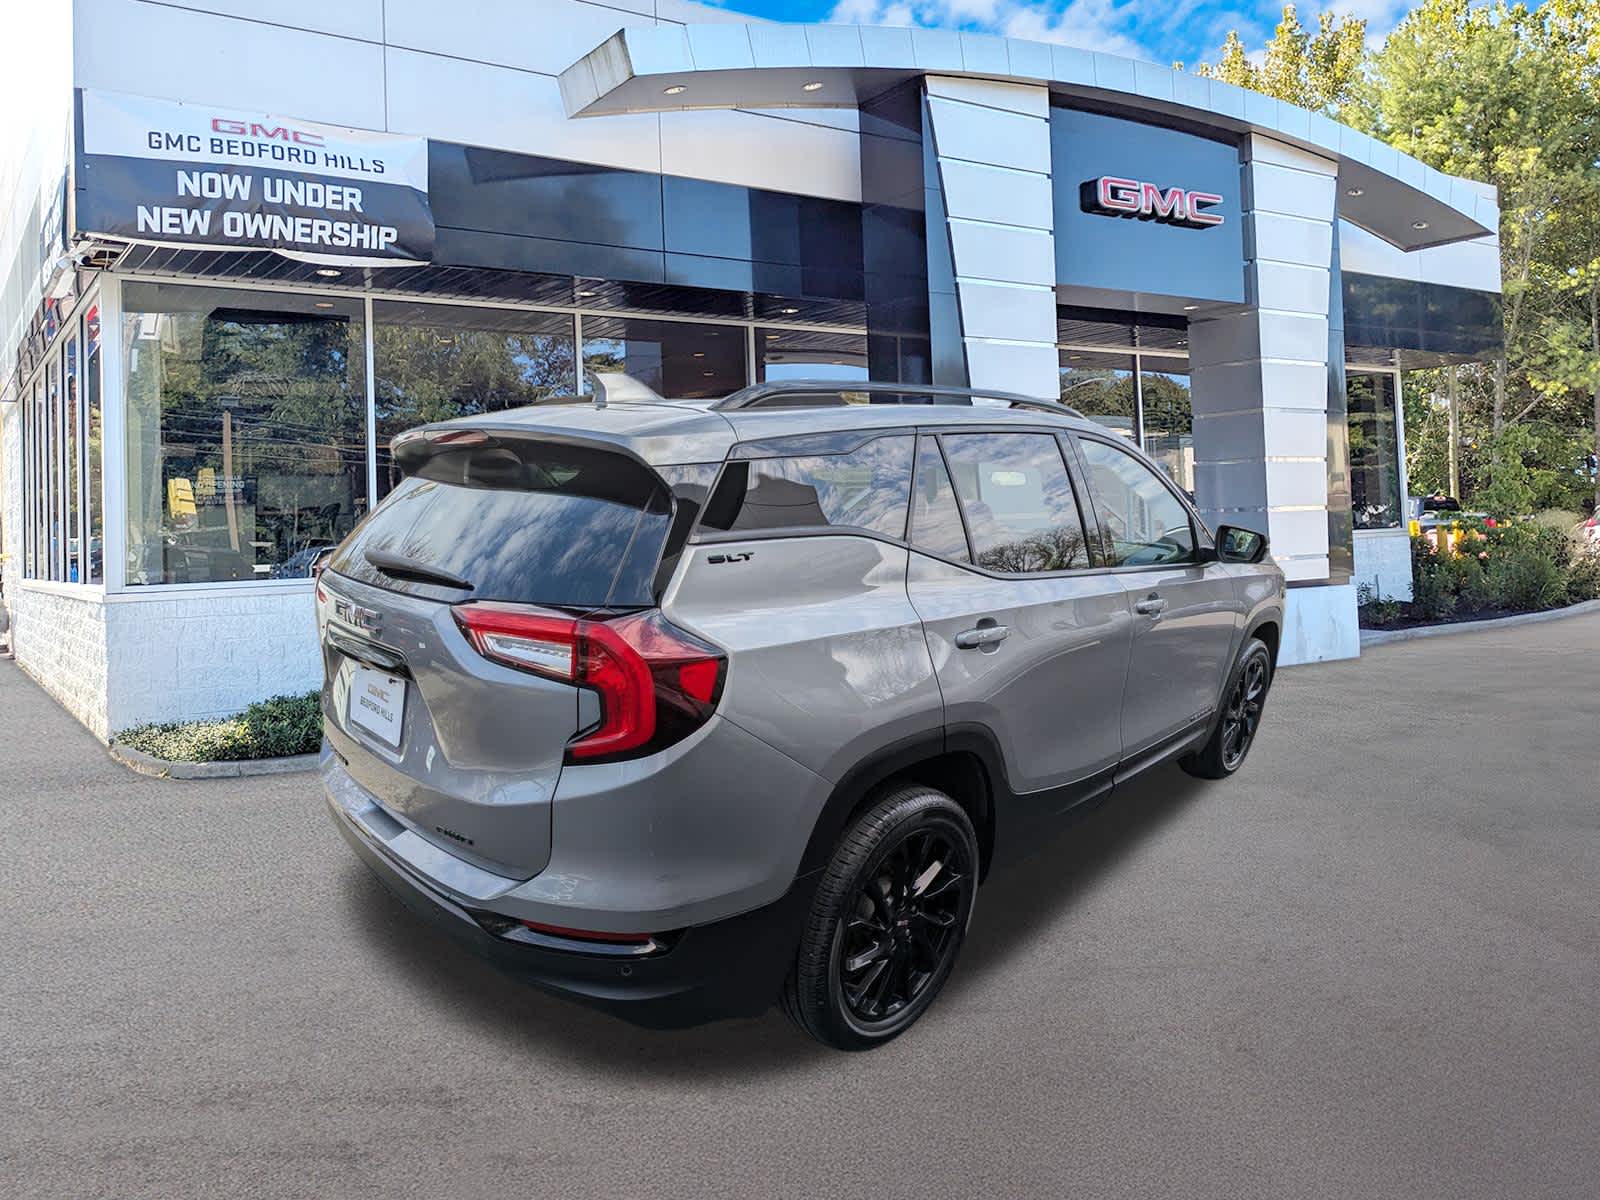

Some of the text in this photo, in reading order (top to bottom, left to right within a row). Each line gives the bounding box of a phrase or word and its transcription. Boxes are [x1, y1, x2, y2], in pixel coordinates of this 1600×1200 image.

[147, 131, 385, 174] GMC BEDFORD HILLS
[211, 118, 326, 148] GMC
[176, 170, 364, 213] NOW UNDER
[1094, 175, 1225, 226] GMC
[136, 205, 398, 250] NEW OWNERSHIP
